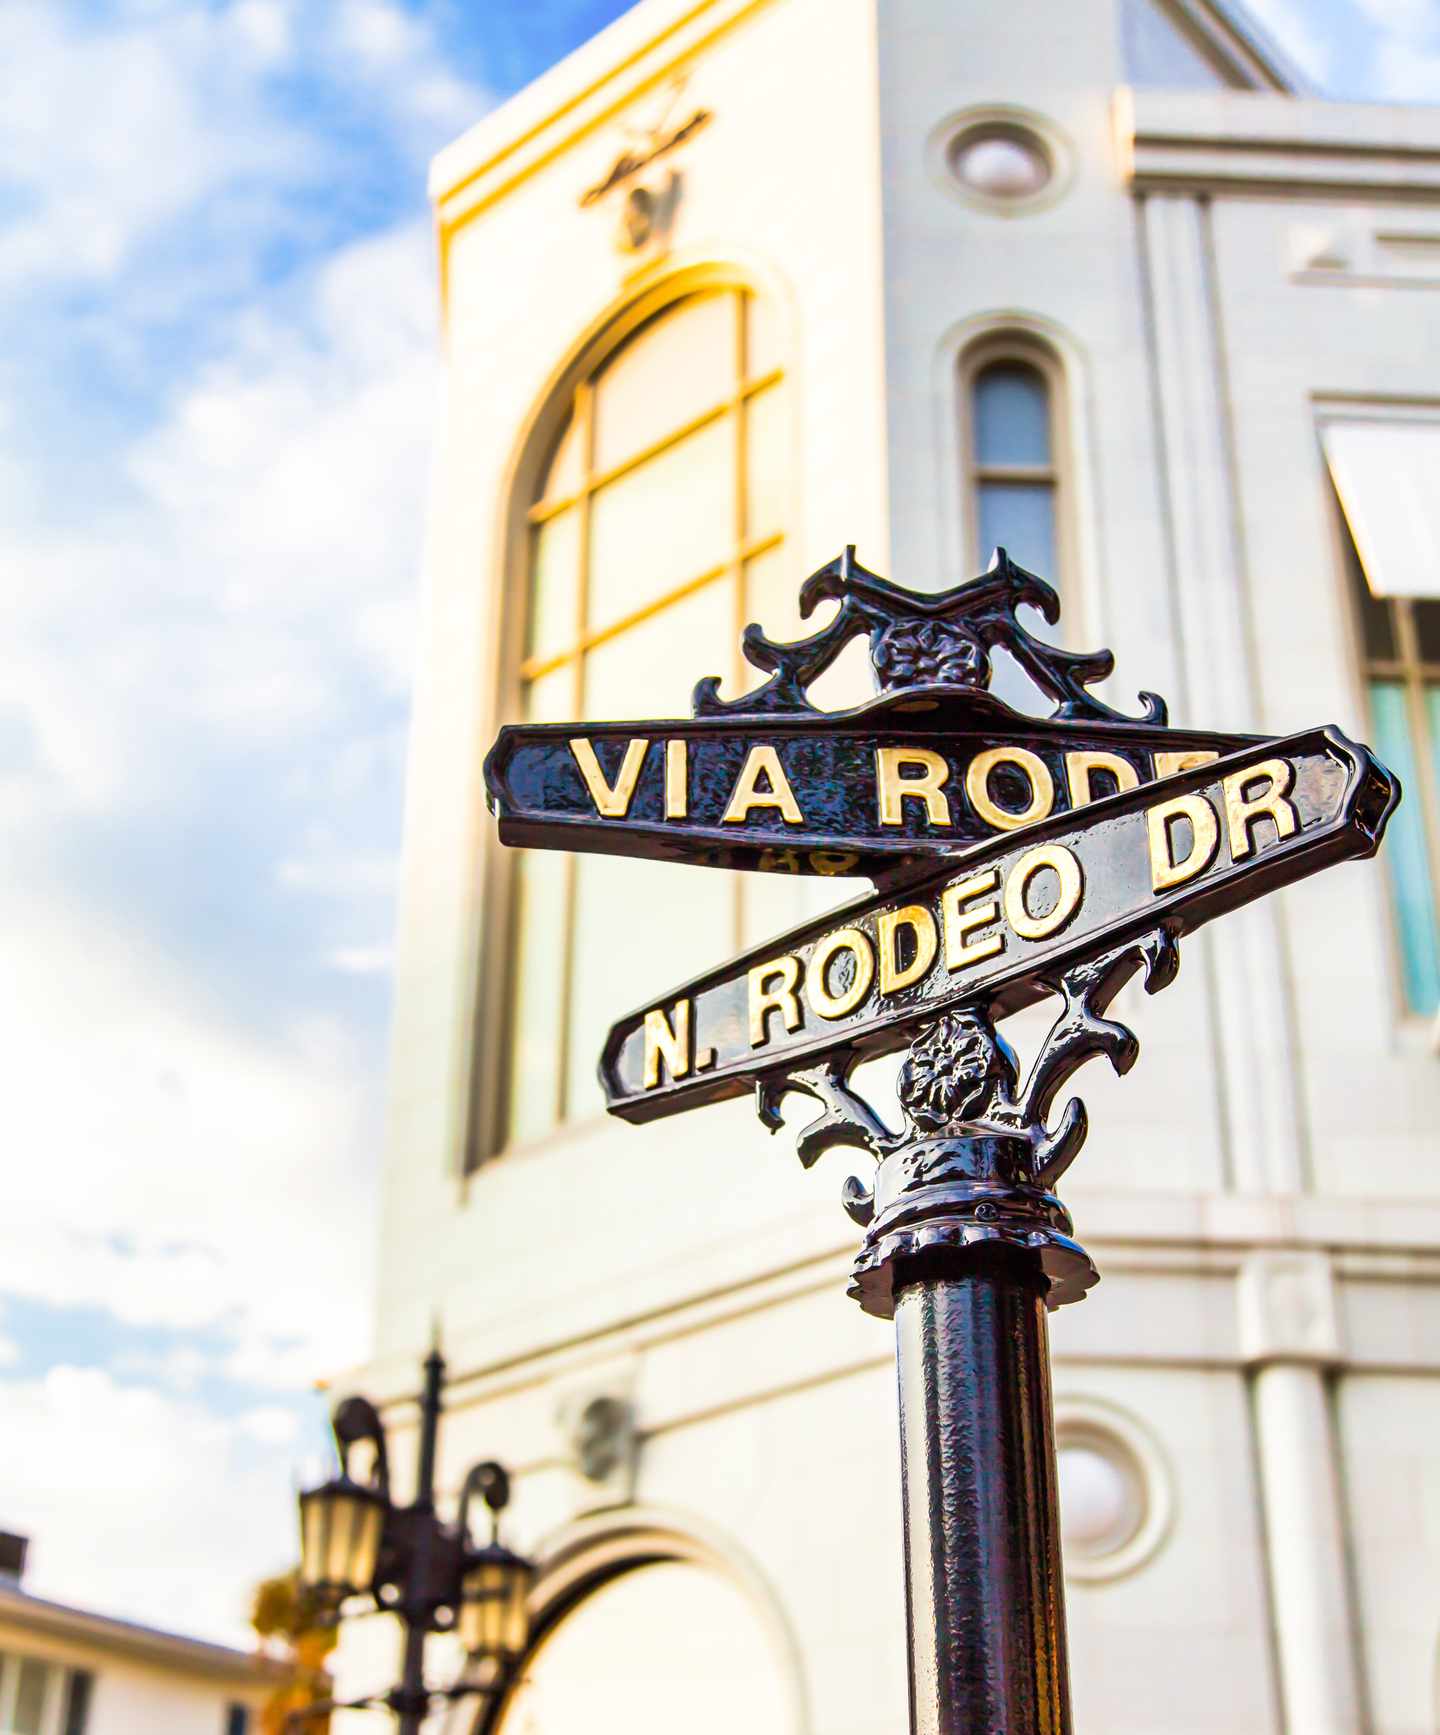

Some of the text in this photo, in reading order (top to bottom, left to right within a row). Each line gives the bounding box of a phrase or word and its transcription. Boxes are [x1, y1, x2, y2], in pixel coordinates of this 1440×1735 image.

[569, 738, 804, 823] VIA
[643, 757, 1297, 1090] N. RODEO DR
